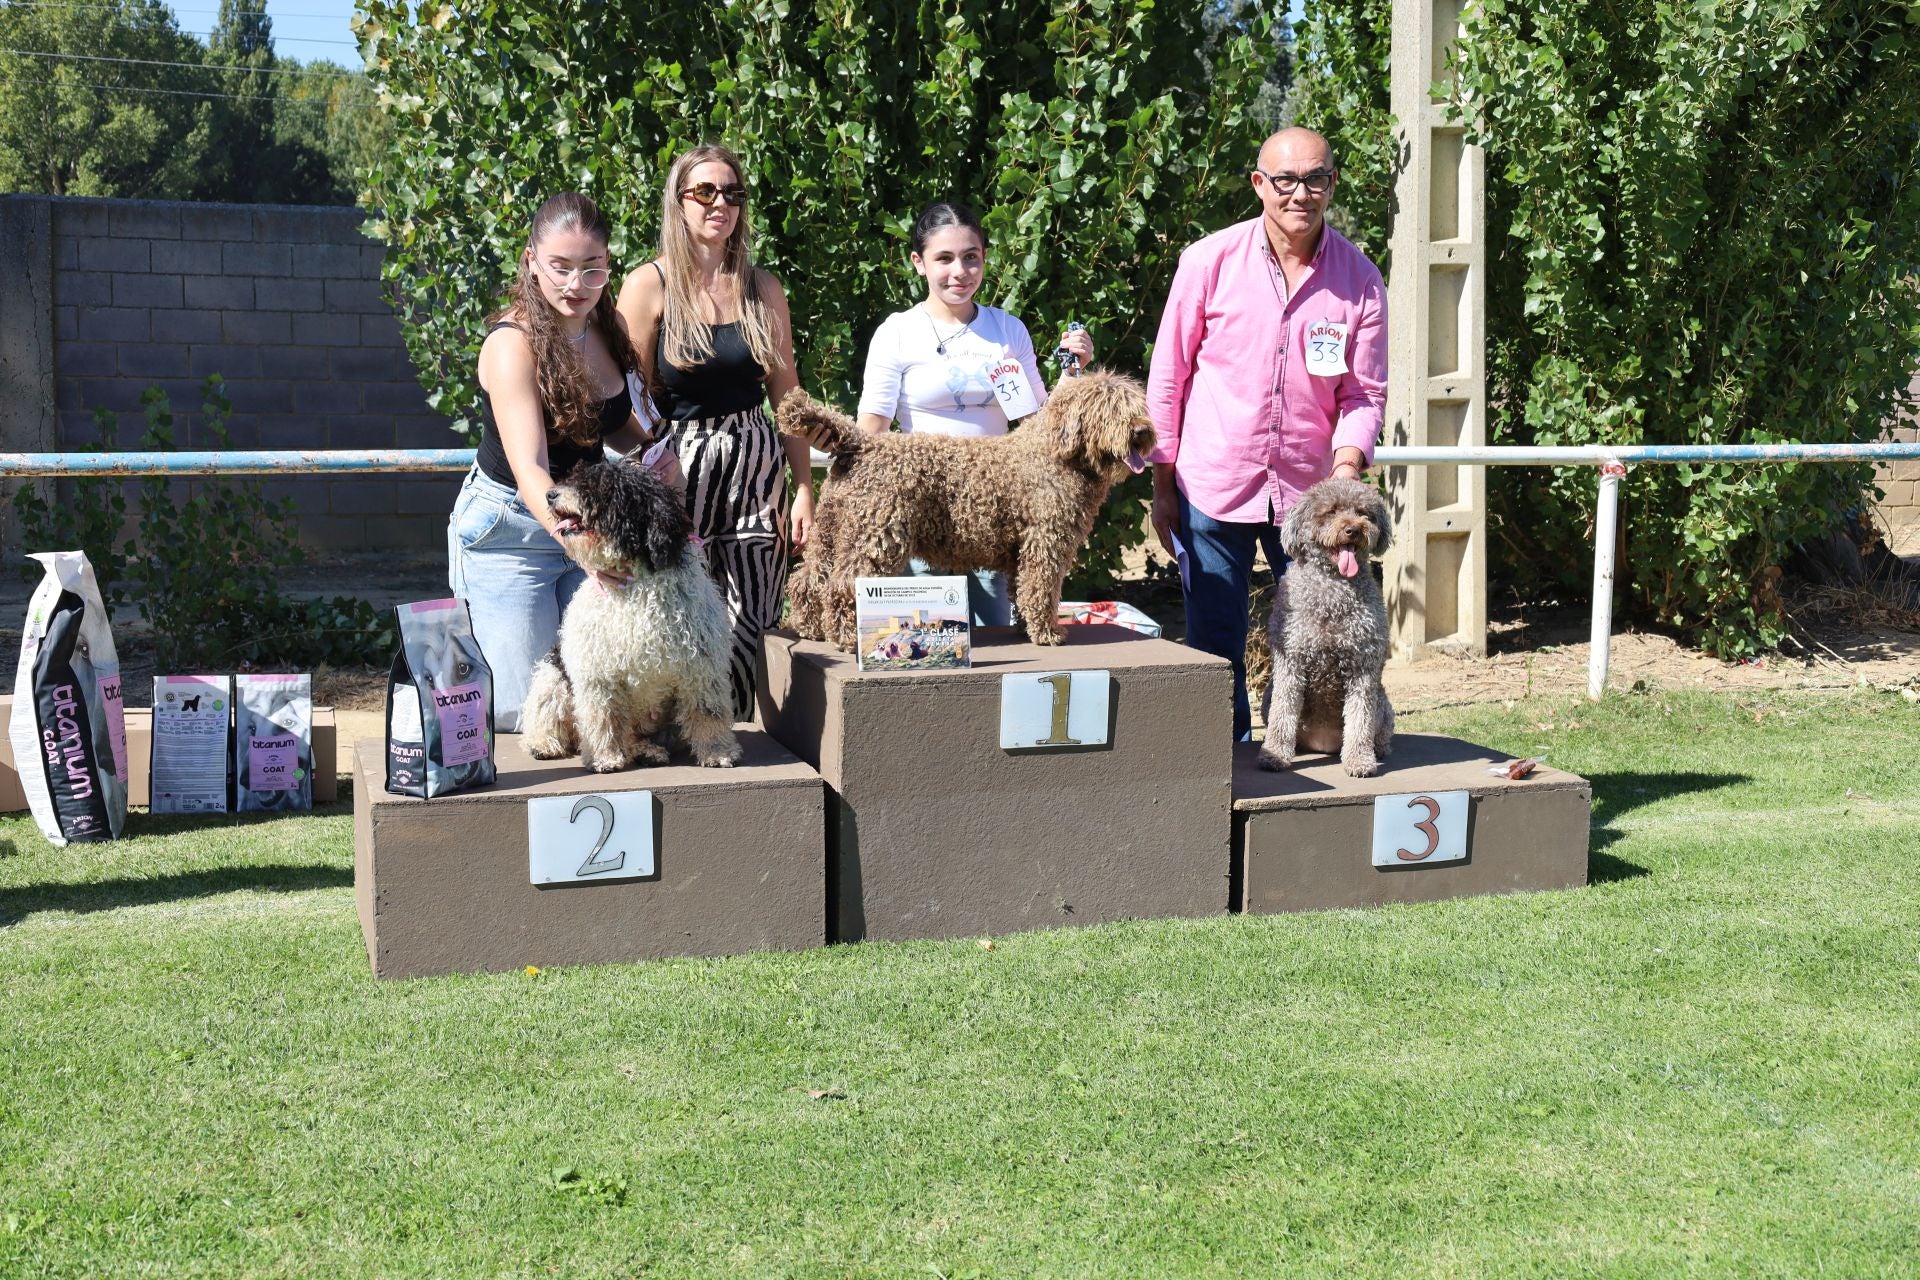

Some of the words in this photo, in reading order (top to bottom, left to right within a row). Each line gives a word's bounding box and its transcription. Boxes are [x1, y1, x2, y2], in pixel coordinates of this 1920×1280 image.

[1310, 327, 1343, 341] ARION
[1312, 341, 1340, 363] 33
[989, 364, 1020, 383] ARION
[996, 379, 1020, 401] 37
[866, 587, 883, 598] VII
[930, 628, 959, 636] CLASE
[436, 690, 481, 707] titanium
[1035, 672, 1082, 745] 1
[52, 684, 93, 800] titanium
[456, 728, 478, 740] COAT
[43, 729, 61, 765] COAT
[252, 739, 295, 749] titanium
[263, 765, 286, 773] COAT
[569, 795, 626, 876] 2
[1396, 795, 1441, 861] 3
